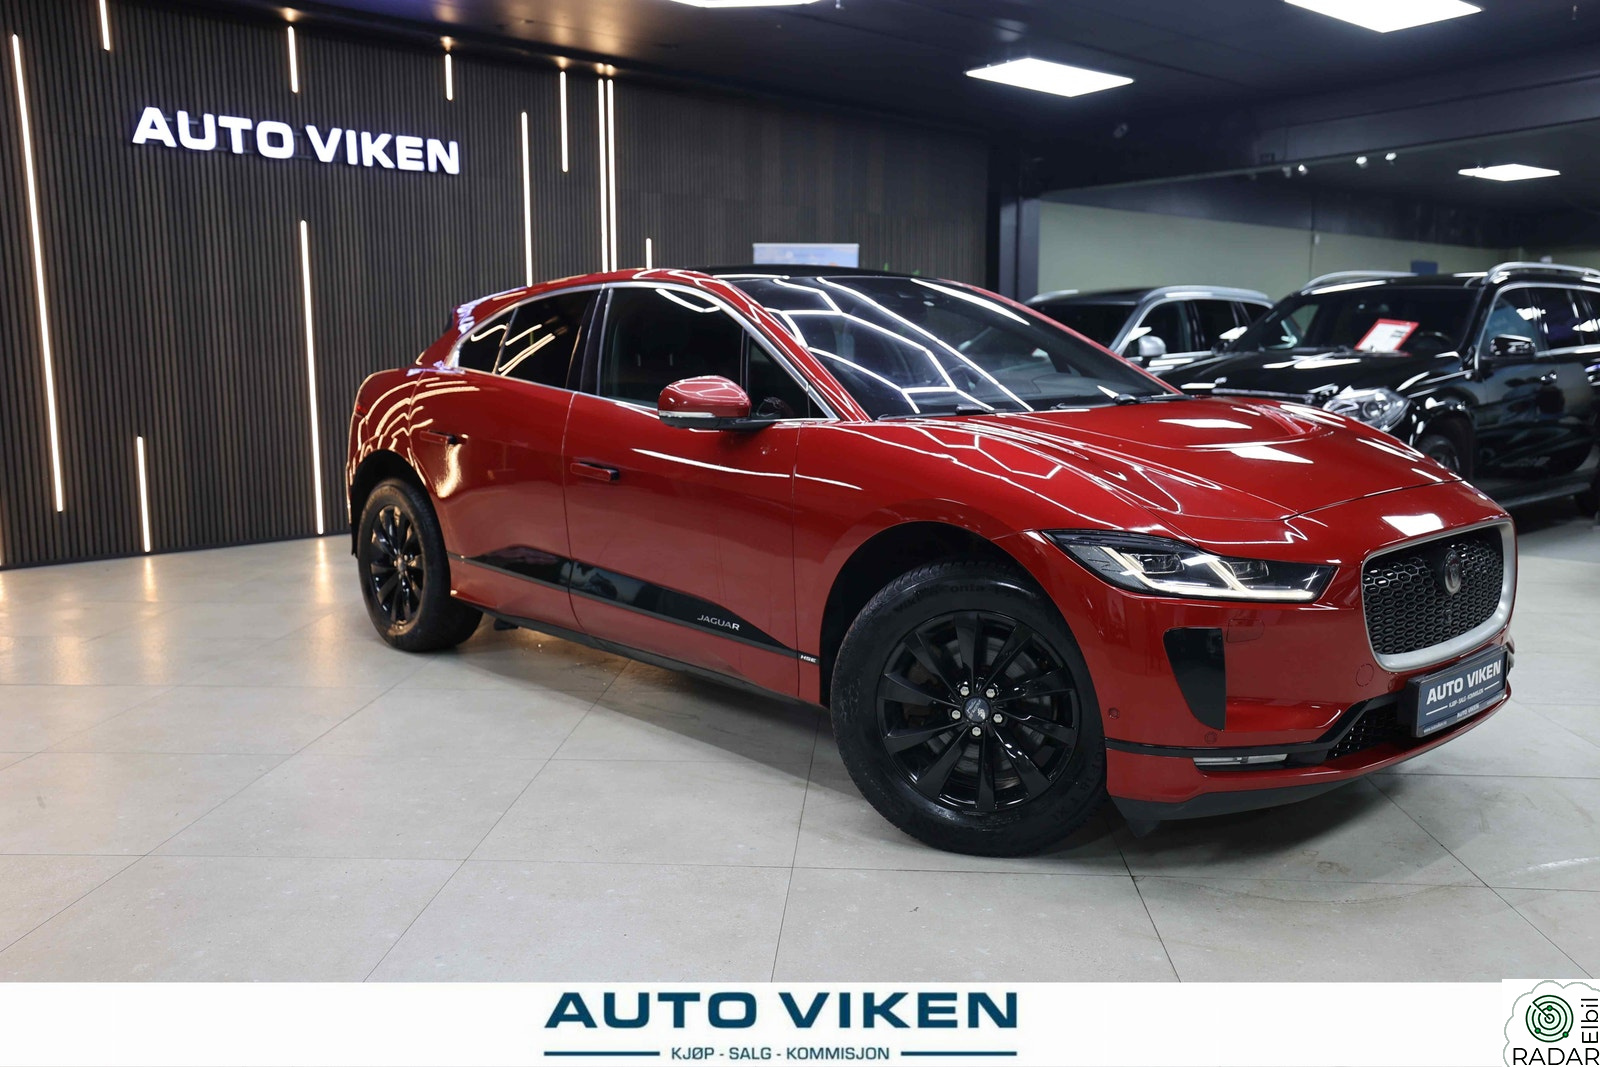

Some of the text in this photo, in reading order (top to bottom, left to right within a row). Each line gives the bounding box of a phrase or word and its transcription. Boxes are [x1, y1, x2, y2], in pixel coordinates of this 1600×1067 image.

[132, 106, 460, 175] AUTO VIKEN
[697, 614, 740, 631] JAGUAR
[800, 654, 817, 663] HSE
[1426, 677, 1463, 705] AUTO
[1466, 660, 1502, 688] VIKEN
